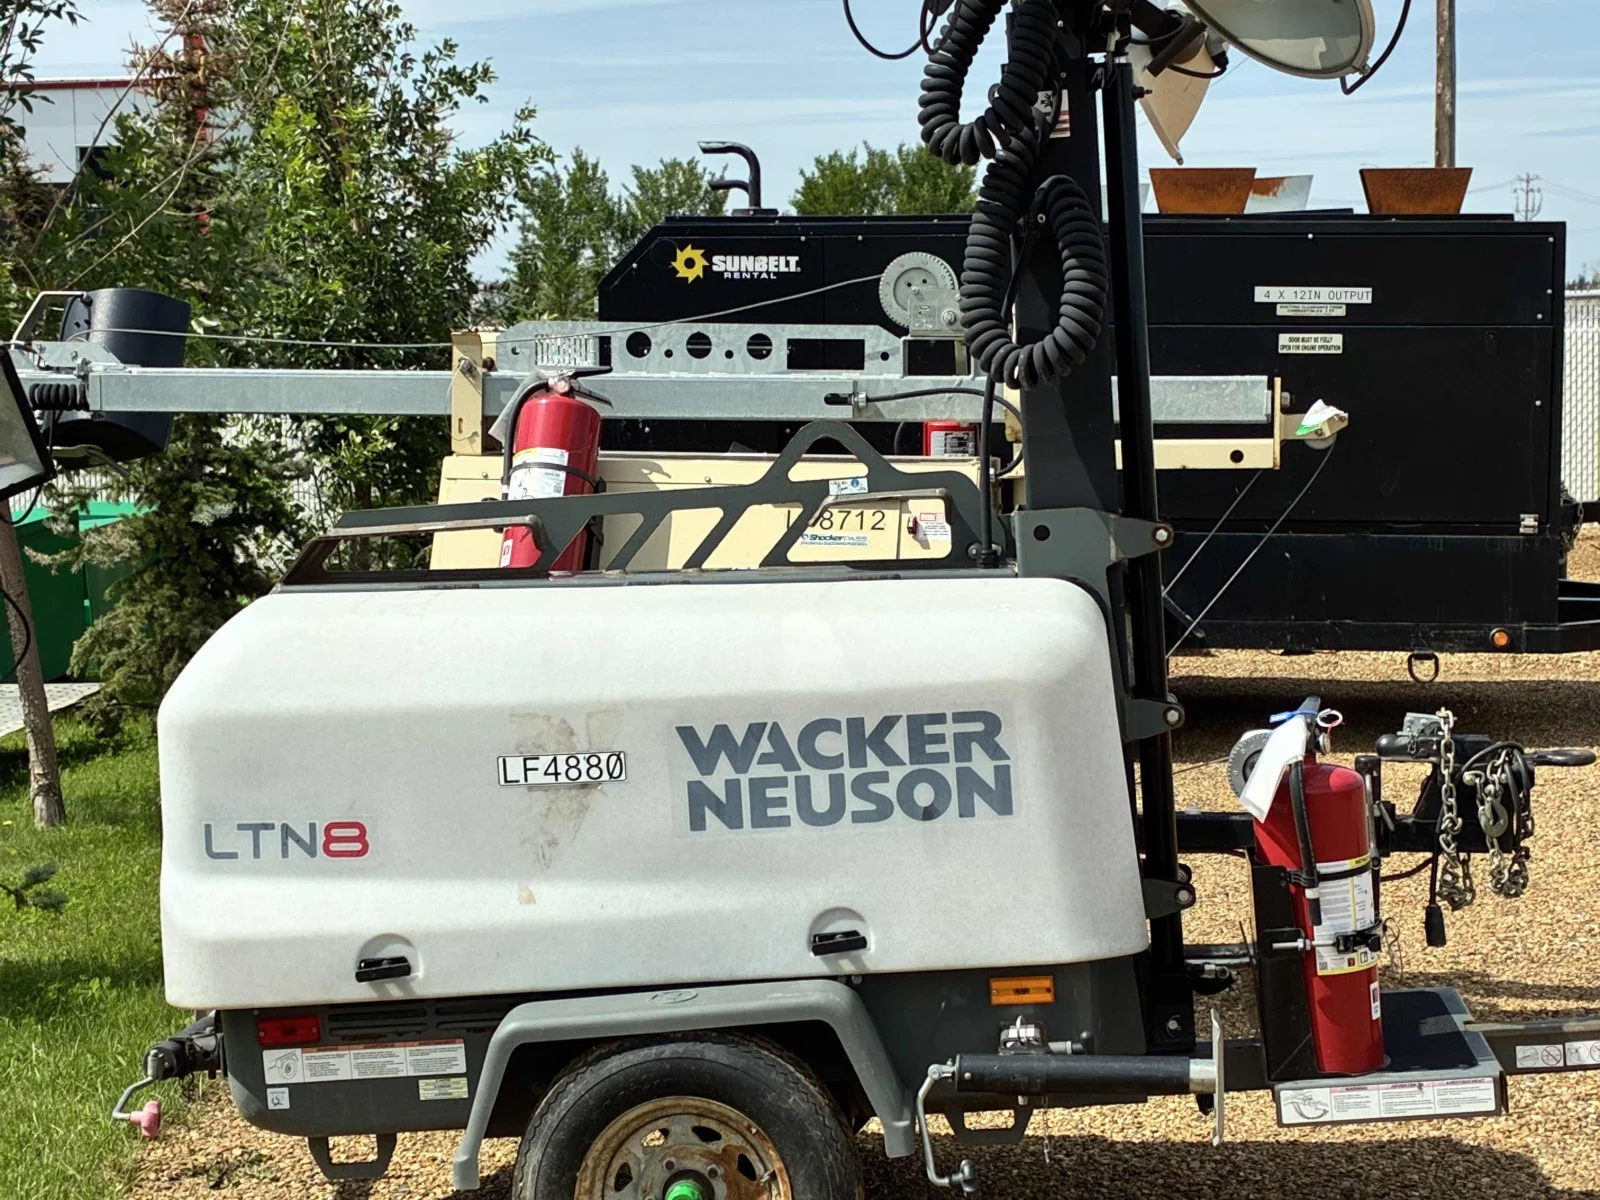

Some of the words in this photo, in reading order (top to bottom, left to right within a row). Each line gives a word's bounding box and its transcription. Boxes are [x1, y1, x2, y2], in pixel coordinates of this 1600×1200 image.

[712, 255, 799, 272] SUNBELT
[1263, 290, 1271, 299] 4
[1278, 290, 1285, 299] X
[1293, 290, 1321, 300] 12IN
[1328, 290, 1371, 301] OUTPUT
[675, 710, 1011, 776] WACKER
[502, 752, 624, 784] LF4880
[687, 764, 1014, 831] NEUSON
[204, 821, 369, 859] LTN8
